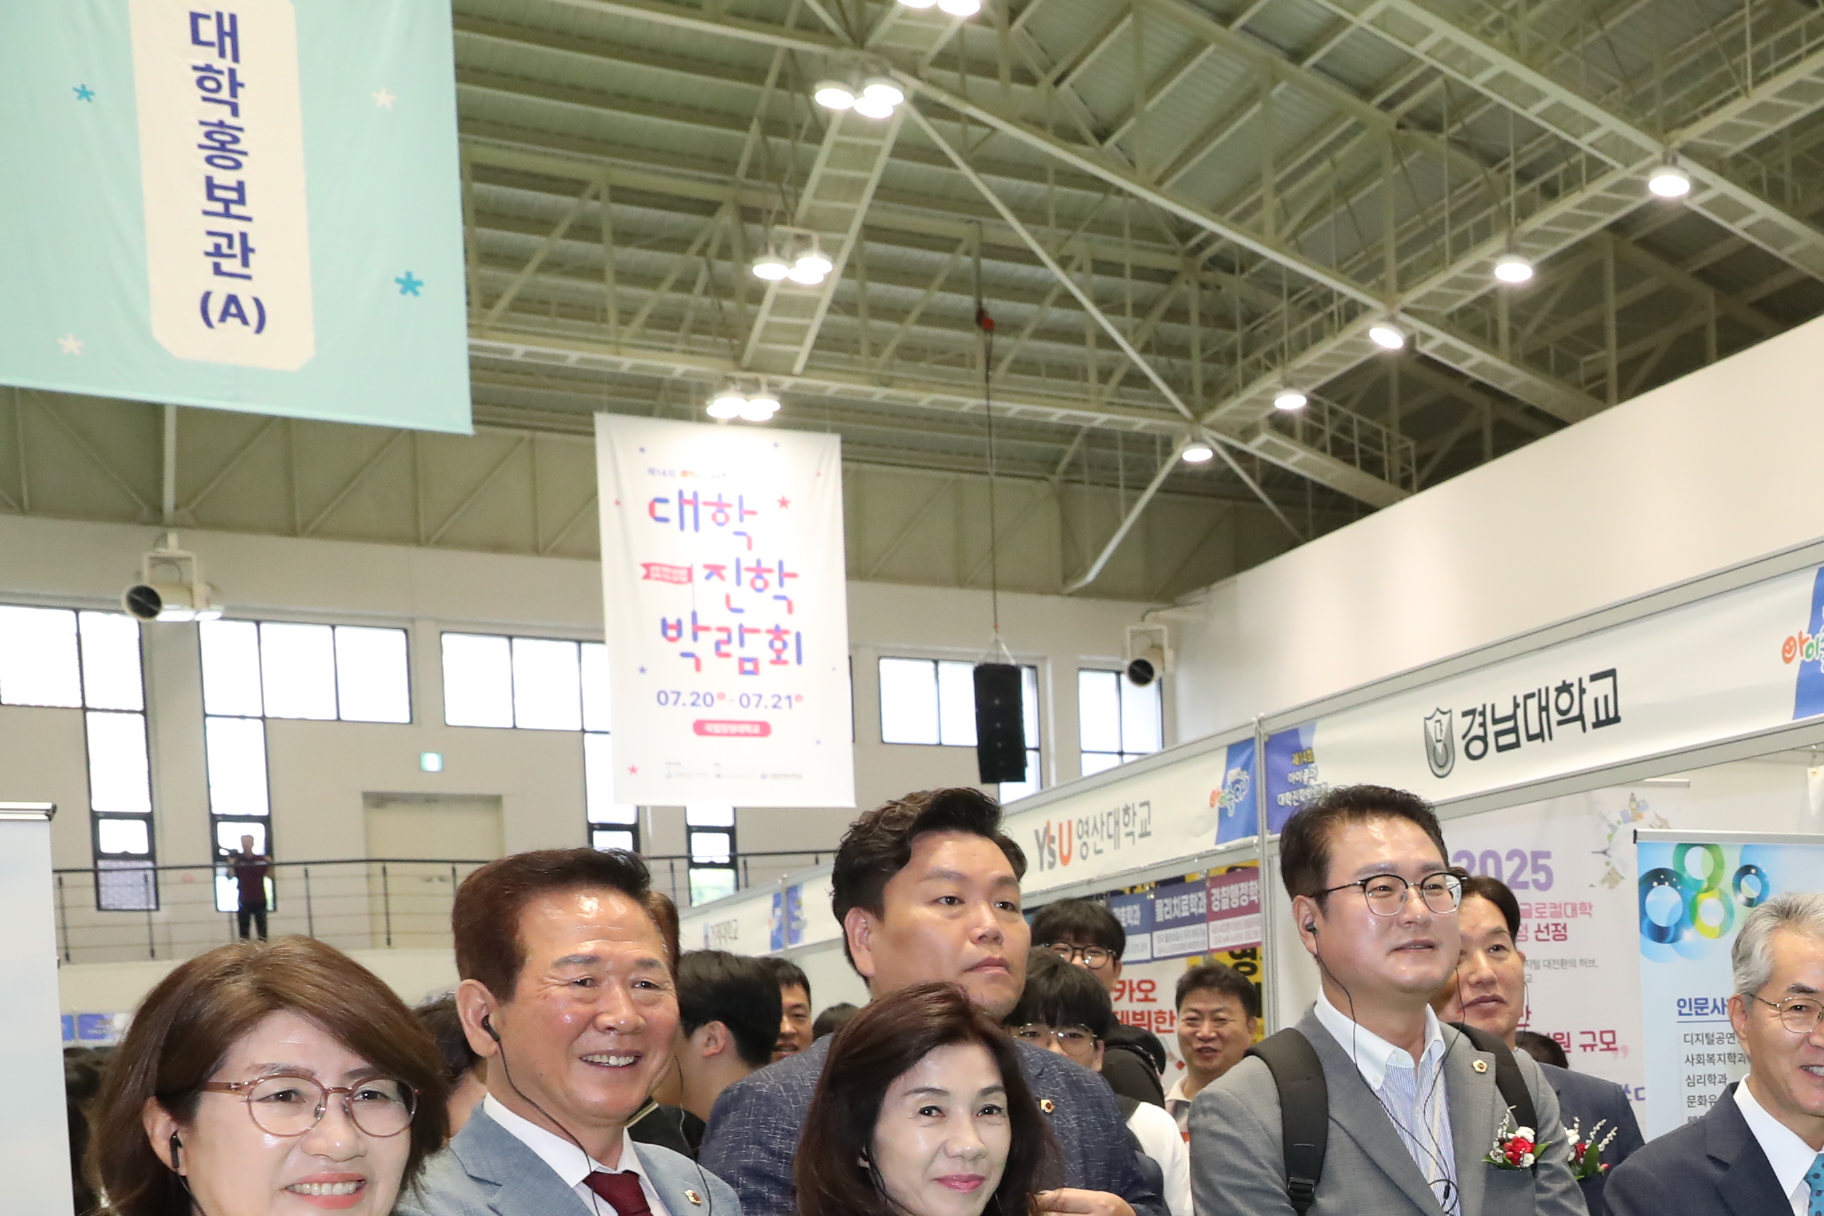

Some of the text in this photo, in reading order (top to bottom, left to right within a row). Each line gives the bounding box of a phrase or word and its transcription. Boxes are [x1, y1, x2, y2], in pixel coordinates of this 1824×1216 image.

[189, 10, 256, 281] 대학홍보관
[200, 290, 267, 335] (A)
[648, 489, 758, 551] 대학
[702, 556, 799, 615] 진학
[661, 610, 803, 676] 박람회
[656, 689, 794, 710] 07.20 07.21
[1460, 667, 1622, 762] 경남대학교
[1076, 799, 1152, 861] 영산대학교
[1452, 848, 1554, 892] 2025
[1534, 922, 1568, 942] 선정
[1676, 996, 1729, 1017] 인문사
[1683, 1032, 1740, 1046] 디지털공연
[1686, 1073, 1728, 1088] 심리학과
